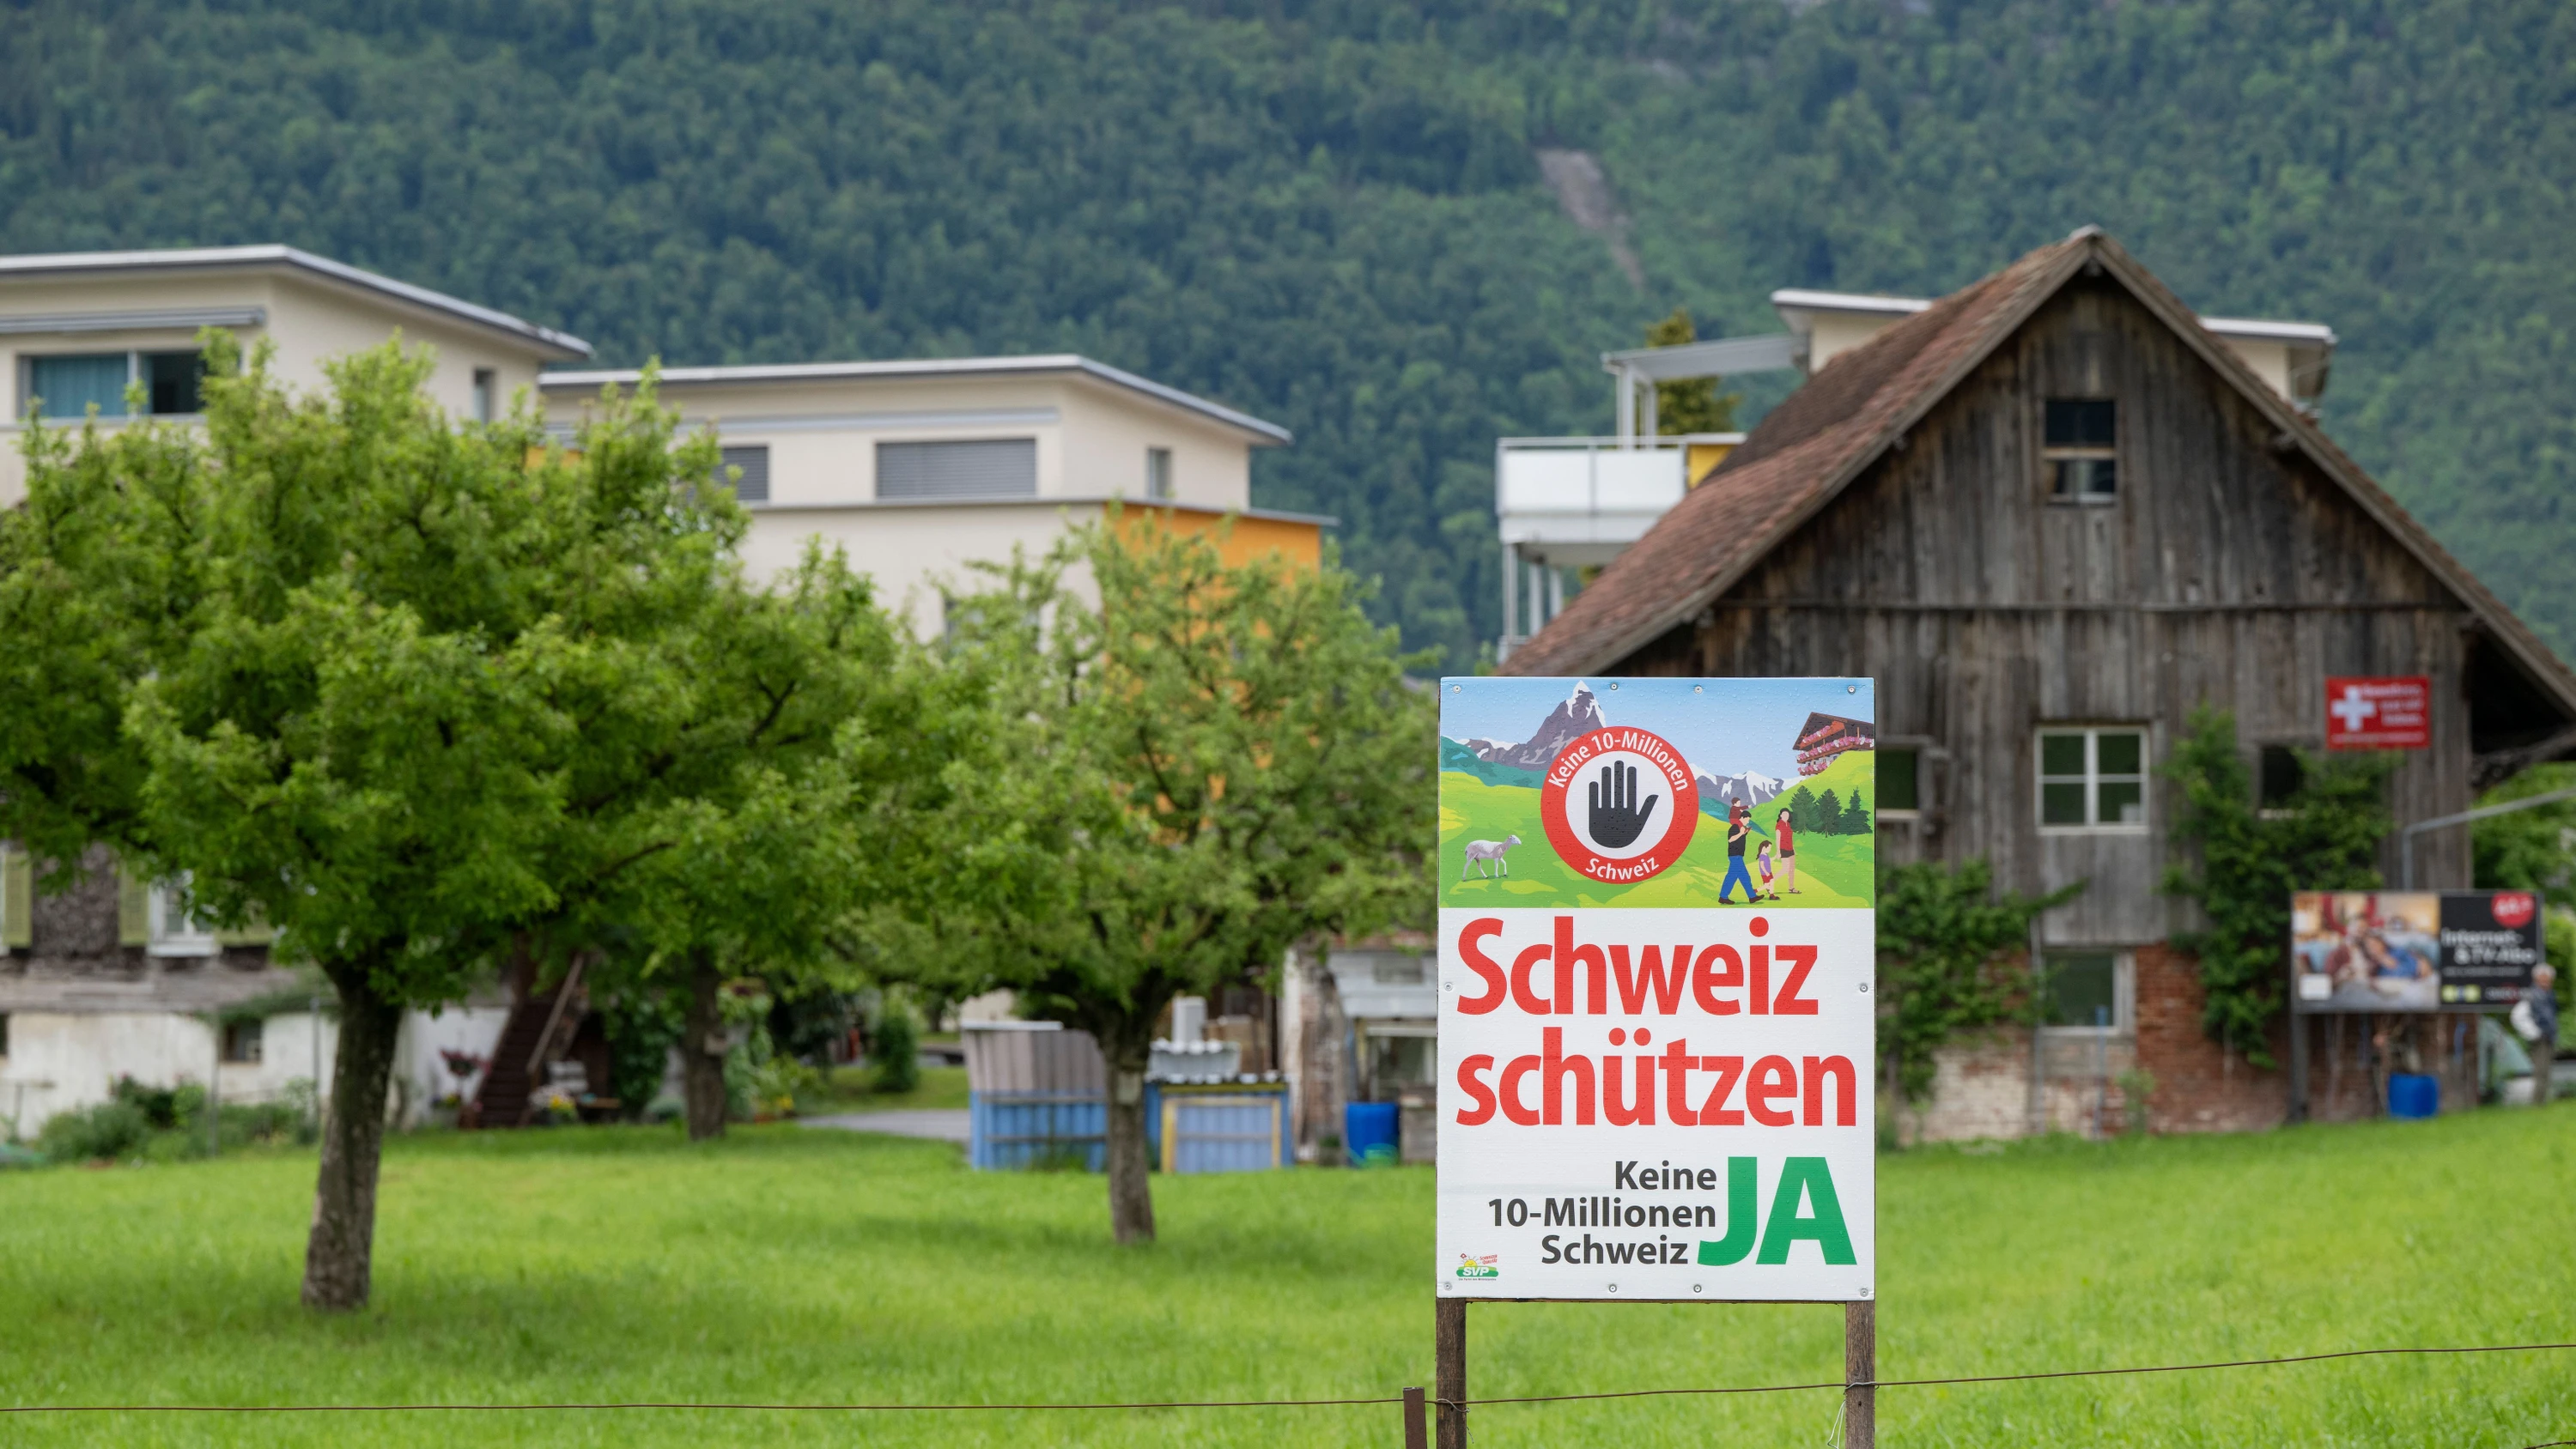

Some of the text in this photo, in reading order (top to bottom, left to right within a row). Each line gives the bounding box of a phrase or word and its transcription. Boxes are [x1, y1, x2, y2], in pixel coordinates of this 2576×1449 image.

[1548, 731, 1688, 791] Keine 10-Millionen
[1585, 857, 1659, 880] Schweiz
[1456, 916, 1820, 1016] Schweiz
[1455, 1027, 1856, 1126] schützen
[1615, 1161, 1716, 1191] Keine
[1488, 1197, 1716, 1228] 10-Millionen
[1697, 1156, 1857, 1266] JA
[1541, 1234, 1688, 1264] Schweiz
[1462, 1266, 1490, 1276] SVP
